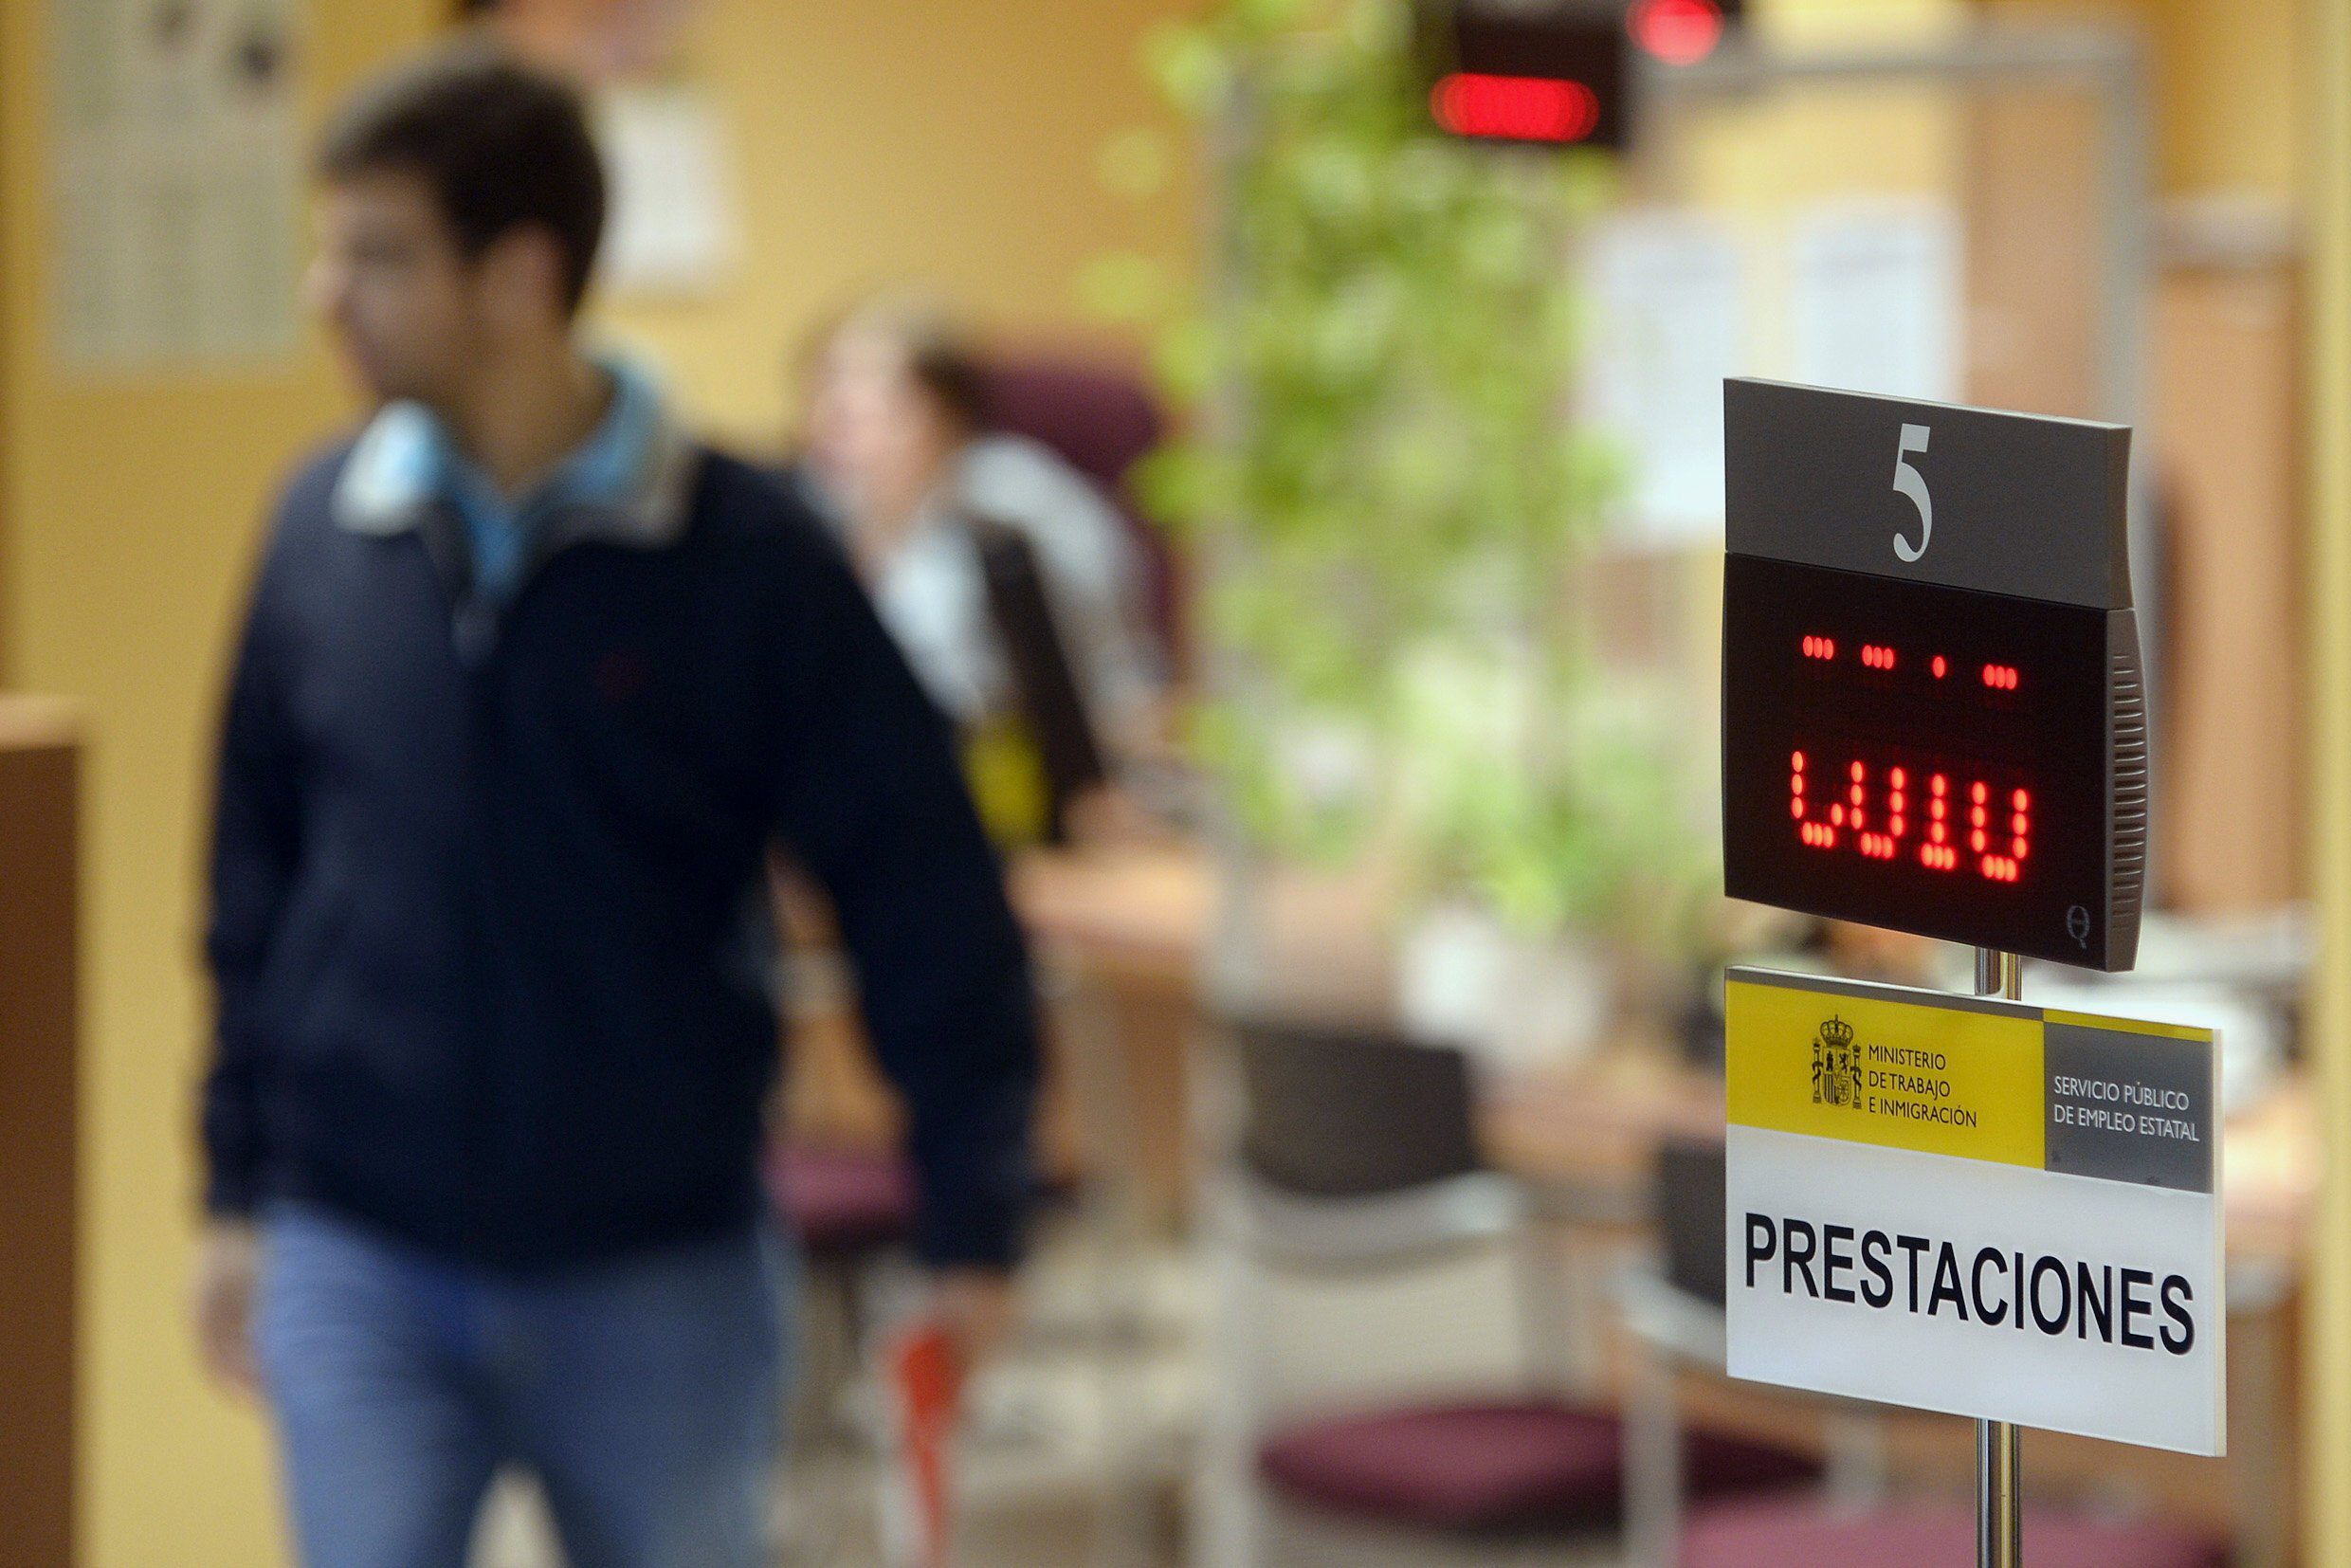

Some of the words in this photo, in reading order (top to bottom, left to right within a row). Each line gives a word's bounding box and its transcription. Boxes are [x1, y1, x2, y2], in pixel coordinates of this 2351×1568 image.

[1892, 423, 1933, 562] 5
[1868, 1044, 1946, 1071] MINISTERIO
[1868, 1070, 1886, 1089] DE
[1889, 1073, 1951, 1101] TRABAJO
[2053, 1075, 2120, 1102] SERVICIO
[2123, 1081, 2190, 1111] PÚBLICO
[1868, 1097, 1876, 1114] E
[1880, 1098, 1977, 1128] INMIGRACIÓN
[2053, 1104, 2074, 1124] DE
[2078, 1107, 2136, 1133] EMPLEO
[2139, 1116, 2200, 1142] ESTATAL
[1745, 1212, 2196, 1357] PRESTACIONES
